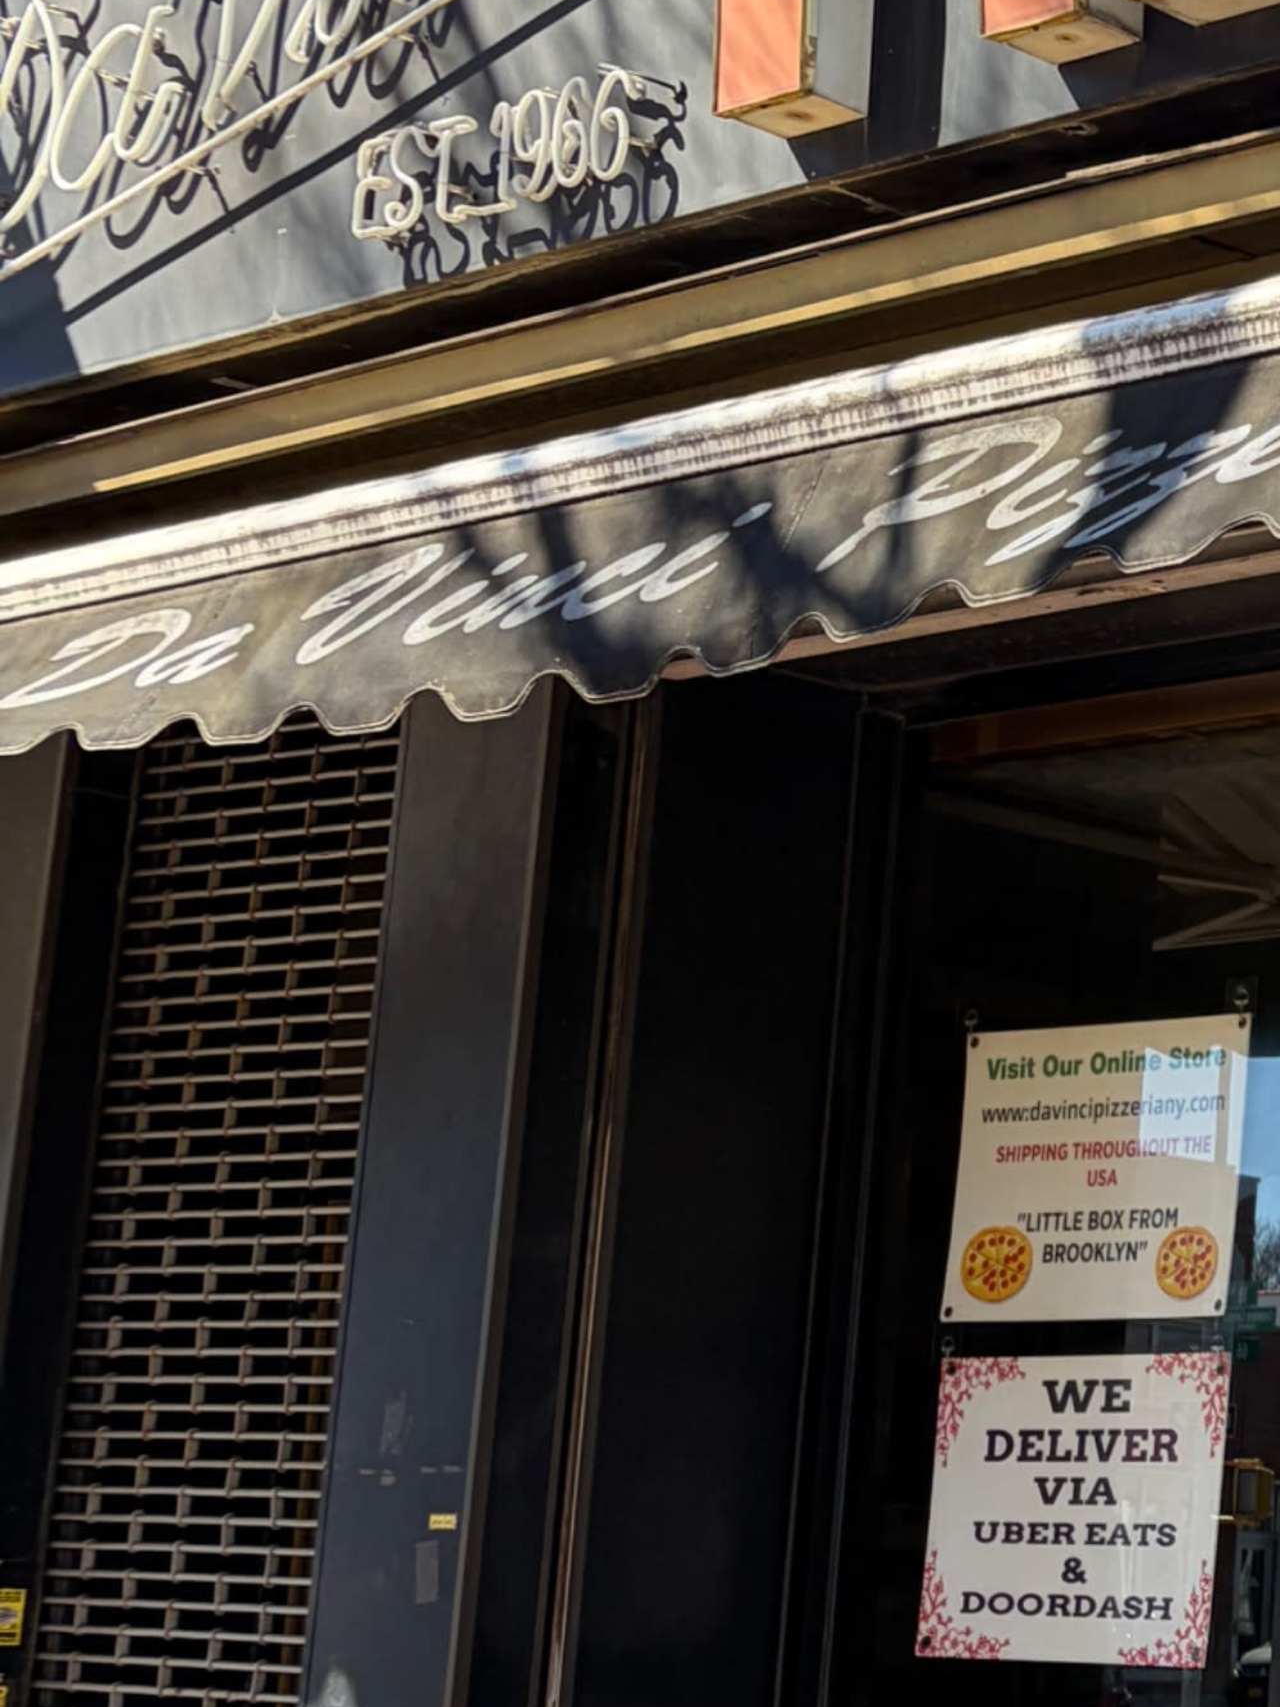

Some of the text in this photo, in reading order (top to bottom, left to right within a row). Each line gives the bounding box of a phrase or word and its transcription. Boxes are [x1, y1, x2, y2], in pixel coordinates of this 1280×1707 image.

[489, 69, 646, 211] 1966
[0, 608, 254, 710] Da
[295, 502, 772, 666] Vinci
[987, 1045, 1227, 1081] Visit Our Online Store
[981, 1093, 1226, 1126] www.davincipizzeriany.com
[994, 1135, 1213, 1164] SHIPPING THROUGHOUT THE
[1086, 1169, 1118, 1188] USA
[1087, 1209, 1124, 1231] BOX
[1129, 1206, 1180, 1230] FROM
[1042, 1378, 1133, 1413] WE
[984, 1429, 1179, 1463] DELIVER
[1033, 1477, 1118, 1506] VIA
[973, 1520, 1178, 1547] UBER EATS
[1061, 1556, 1088, 1584] &
[960, 1591, 1175, 1621] DOORDASH
